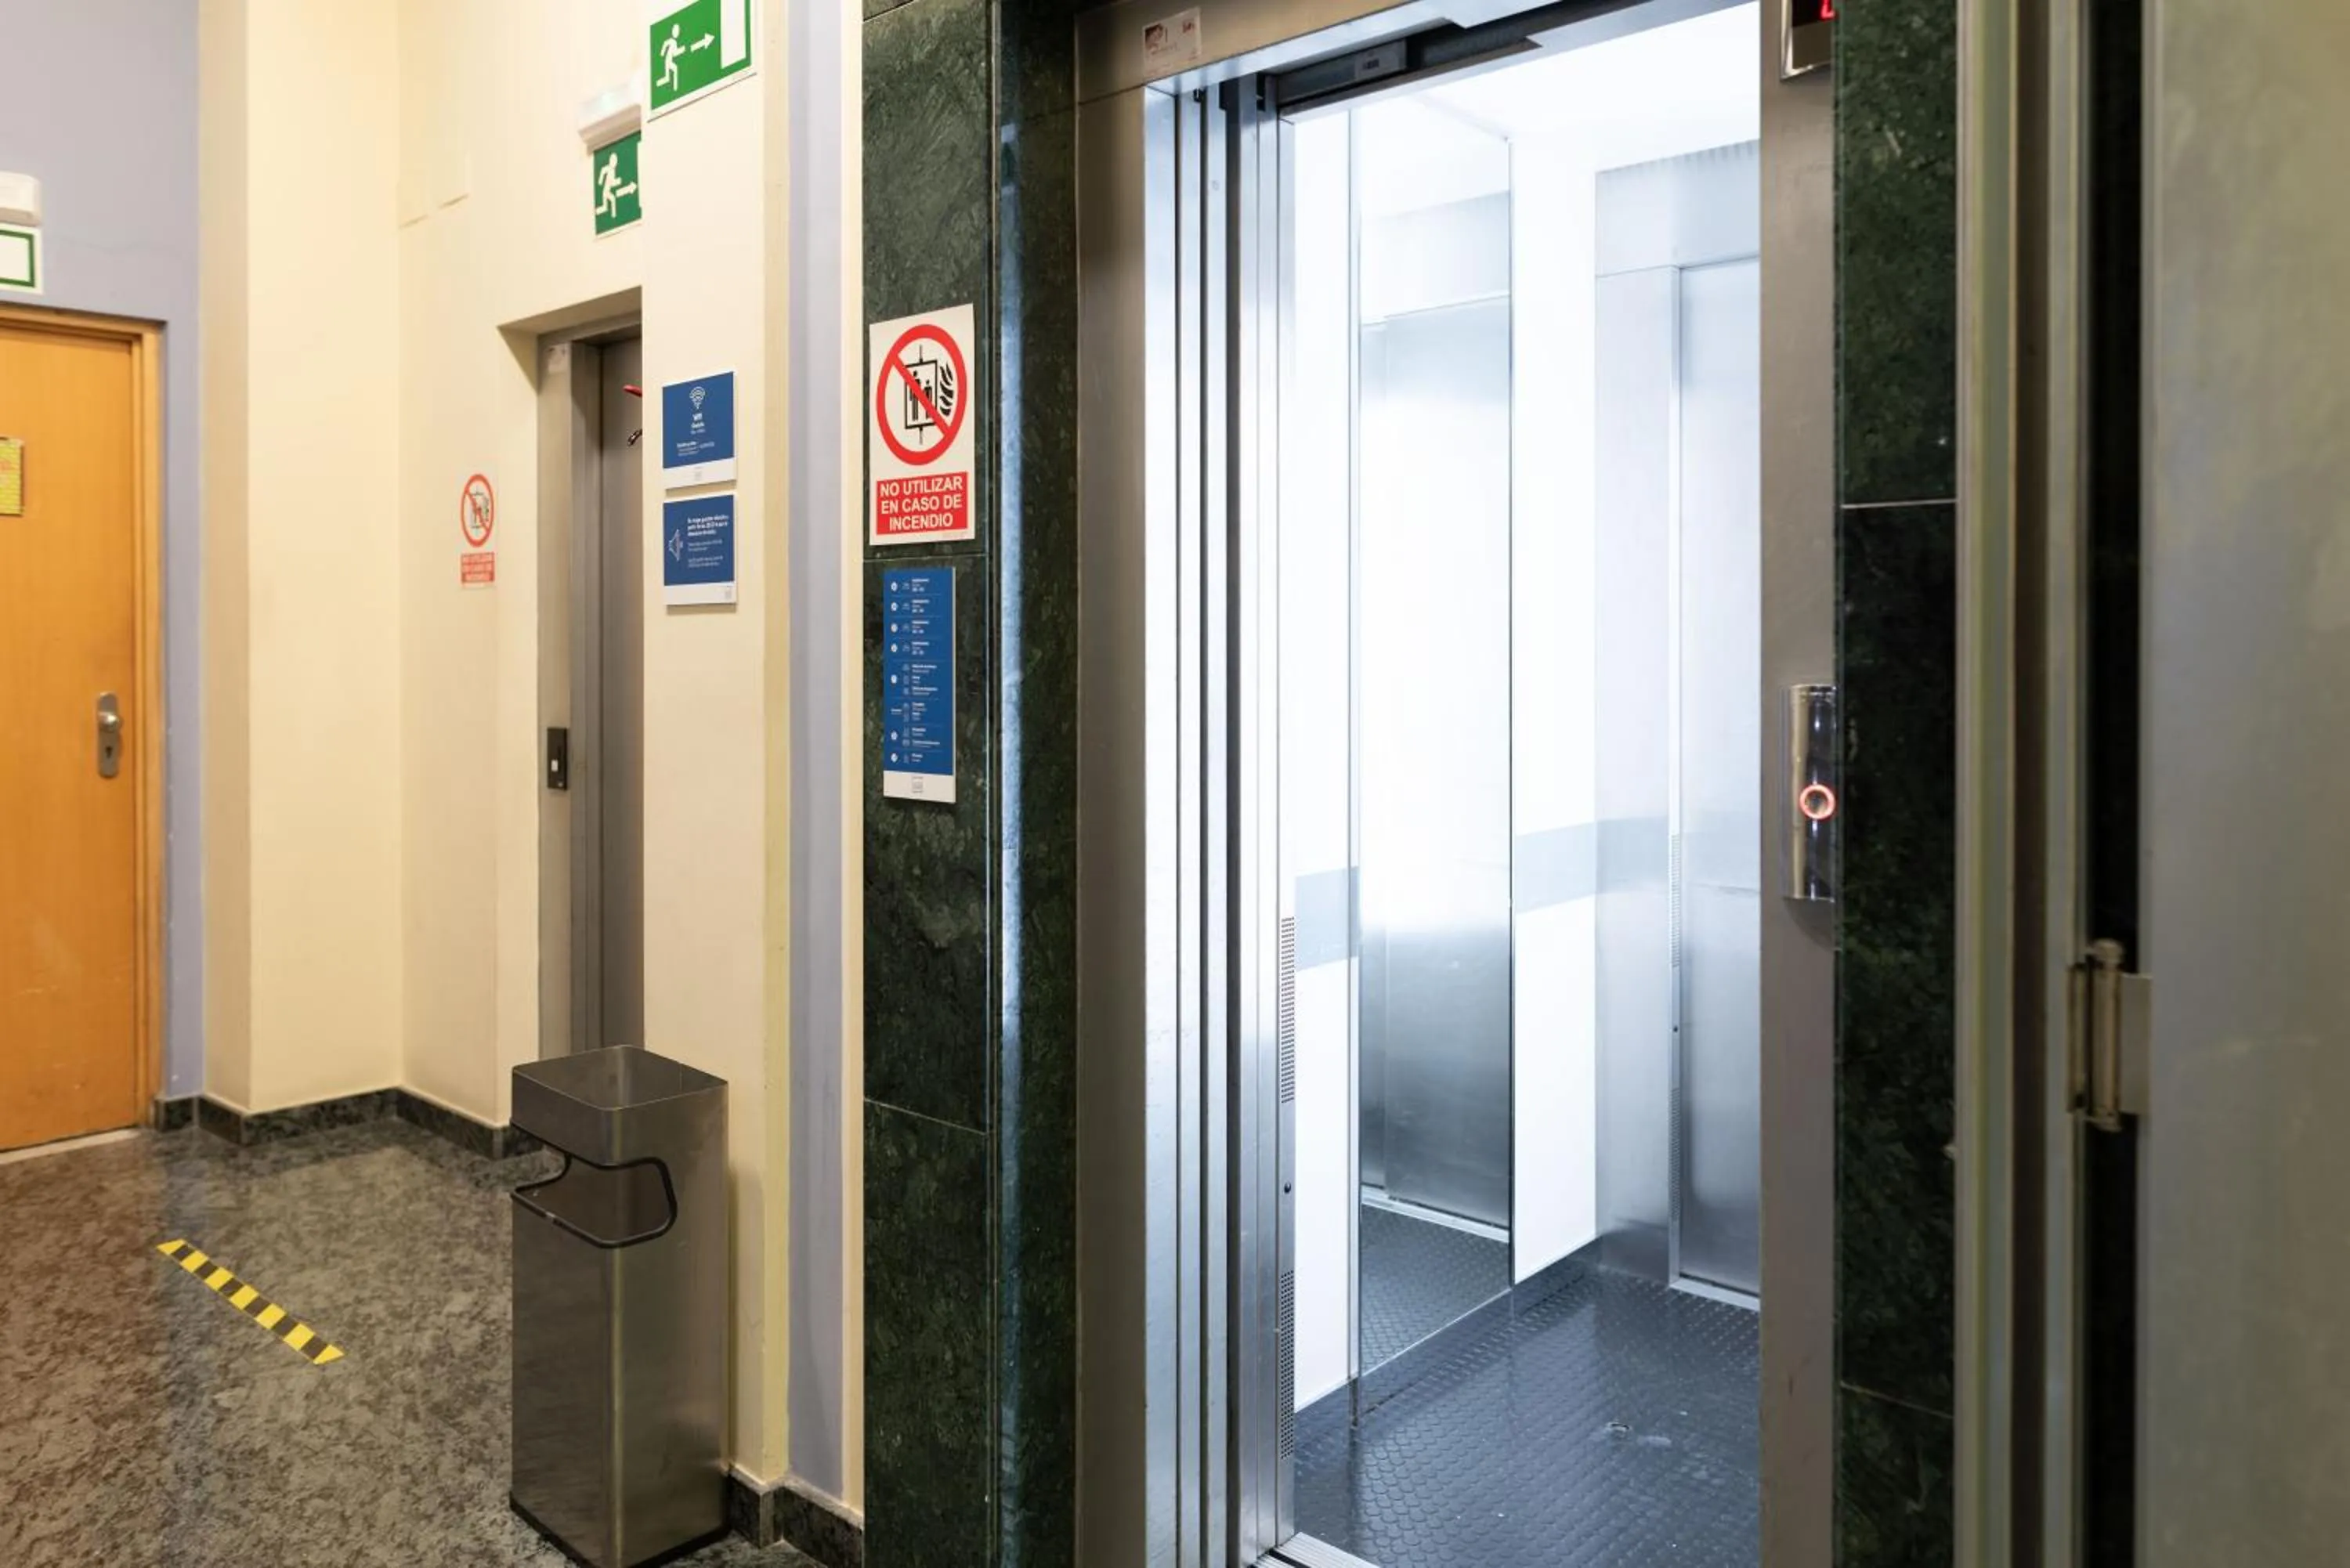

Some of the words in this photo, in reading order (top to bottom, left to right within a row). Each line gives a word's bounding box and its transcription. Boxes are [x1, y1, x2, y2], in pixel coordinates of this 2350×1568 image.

[880, 482, 900, 497] NO
[903, 475, 963, 496] UTILIZAR
[880, 500, 898, 515] EN
[902, 495, 940, 514] CASO
[943, 493, 963, 510] DE
[889, 512, 953, 531] INCENDIO
